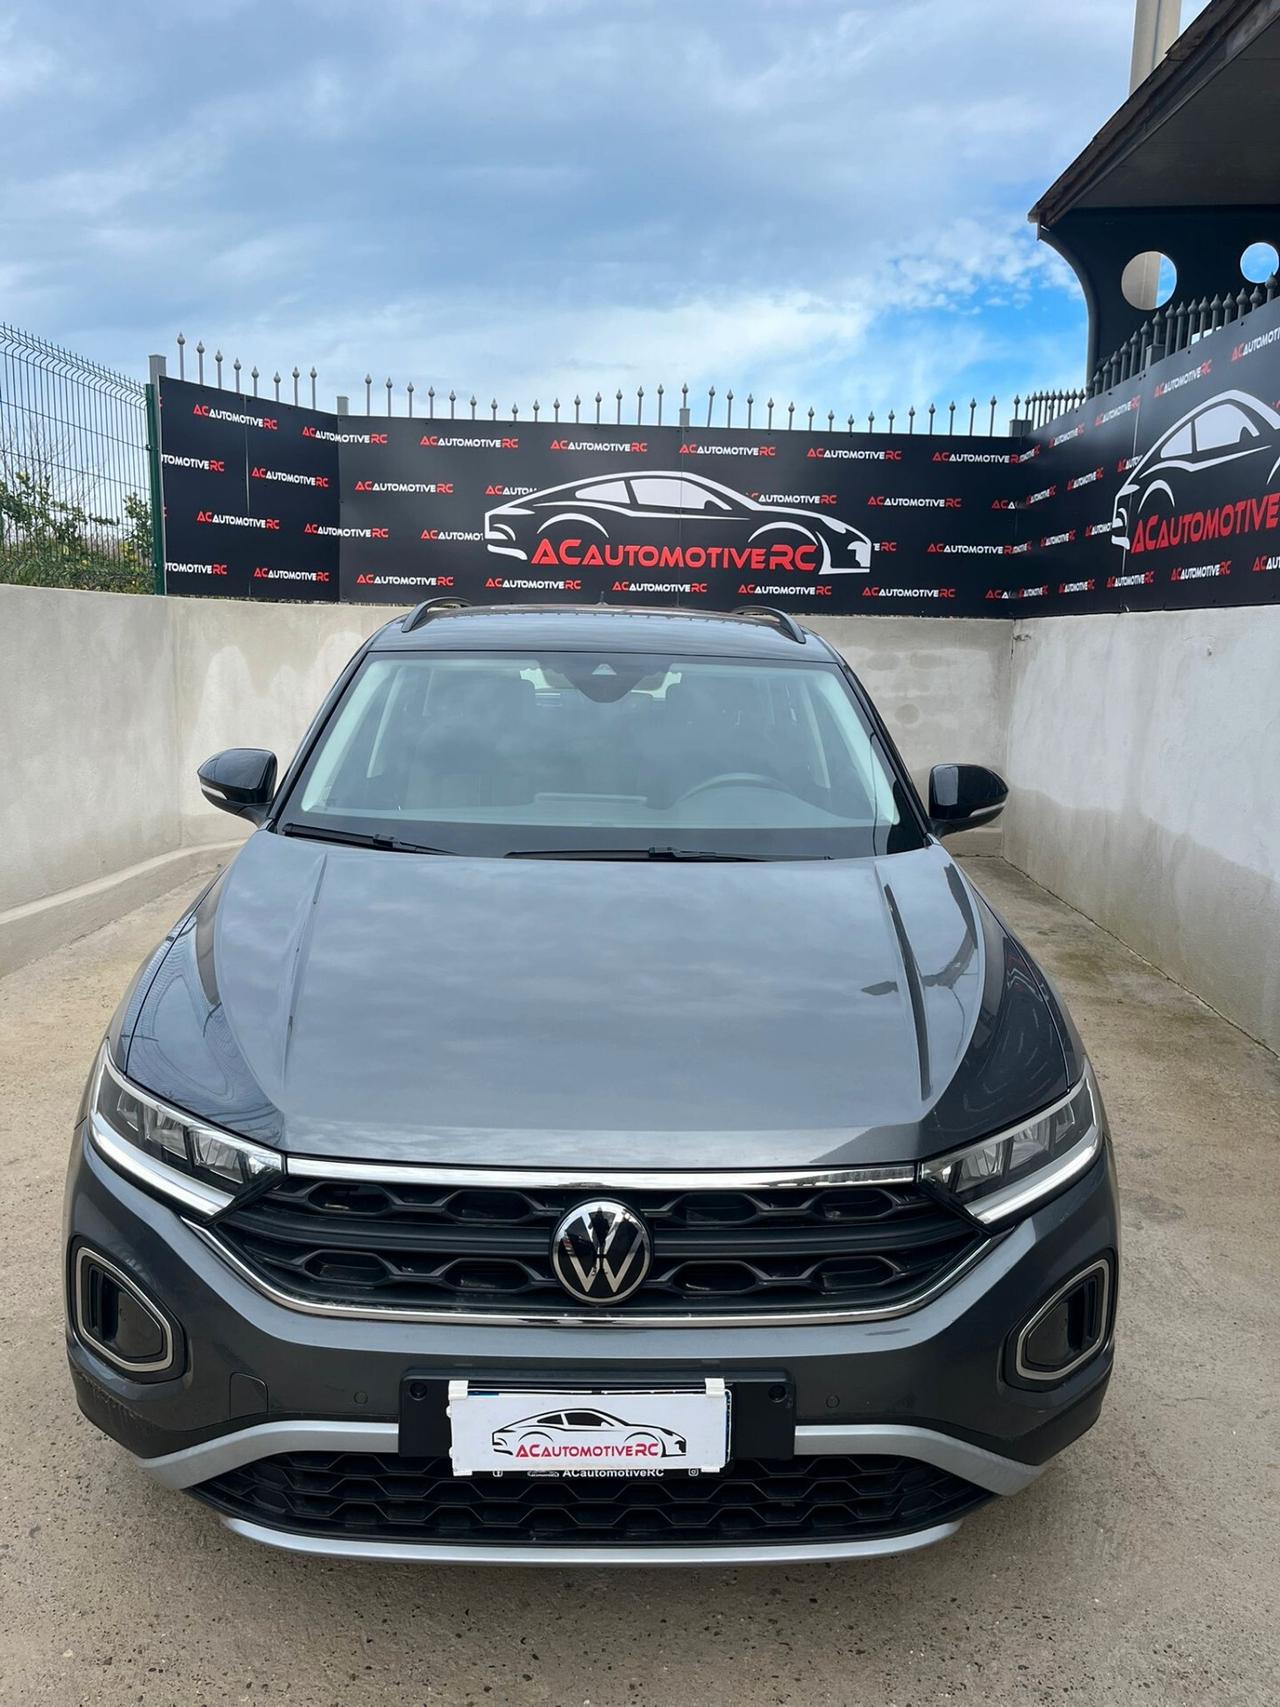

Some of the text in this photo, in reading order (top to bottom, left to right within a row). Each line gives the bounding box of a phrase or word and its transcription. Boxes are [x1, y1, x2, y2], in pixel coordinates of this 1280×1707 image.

[193, 404, 278, 430] ACAUTOMOTIVERC
[302, 426, 388, 445] ACAUTOMOTIVERC
[420, 435, 519, 449] ACAUTOMOTIVERC
[550, 440, 648, 453] ACAUTOMOTIVERC
[679, 443, 776, 456] ACAUTOMOTIVERC
[807, 447, 902, 461] ACAUTOMOTIVERC
[251, 467, 329, 488] ACAUTOMOTIVERC
[355, 481, 454, 494] ACAUTOMOTIVERC
[746, 492, 838, 505] AUTOMOTIVERC
[867, 496, 962, 509] ACAUTOMOTIVERC
[197, 511, 280, 530] ACAUTOMOTIVERC
[304, 523, 389, 539] ACAUTOMOTIVERC
[531, 538, 817, 570] ACAUTOMOTIVERC
[253, 567, 330, 583] ACAUTOMOTIVERC
[356, 574, 455, 587] ACAUTOMOTIVERC
[485, 577, 582, 591] ACAUTOMOTIVERC
[612, 580, 708, 593] ACAUTOMOTIVERC
[737, 584, 833, 596] ACAUTOMOTIVERC
[862, 586, 956, 599] ACAUTOMOTIVERC
[516, 1443, 659, 1457] ACAUTOMOTIVERC
[563, 1468, 664, 1477] ACautomotiveRC
